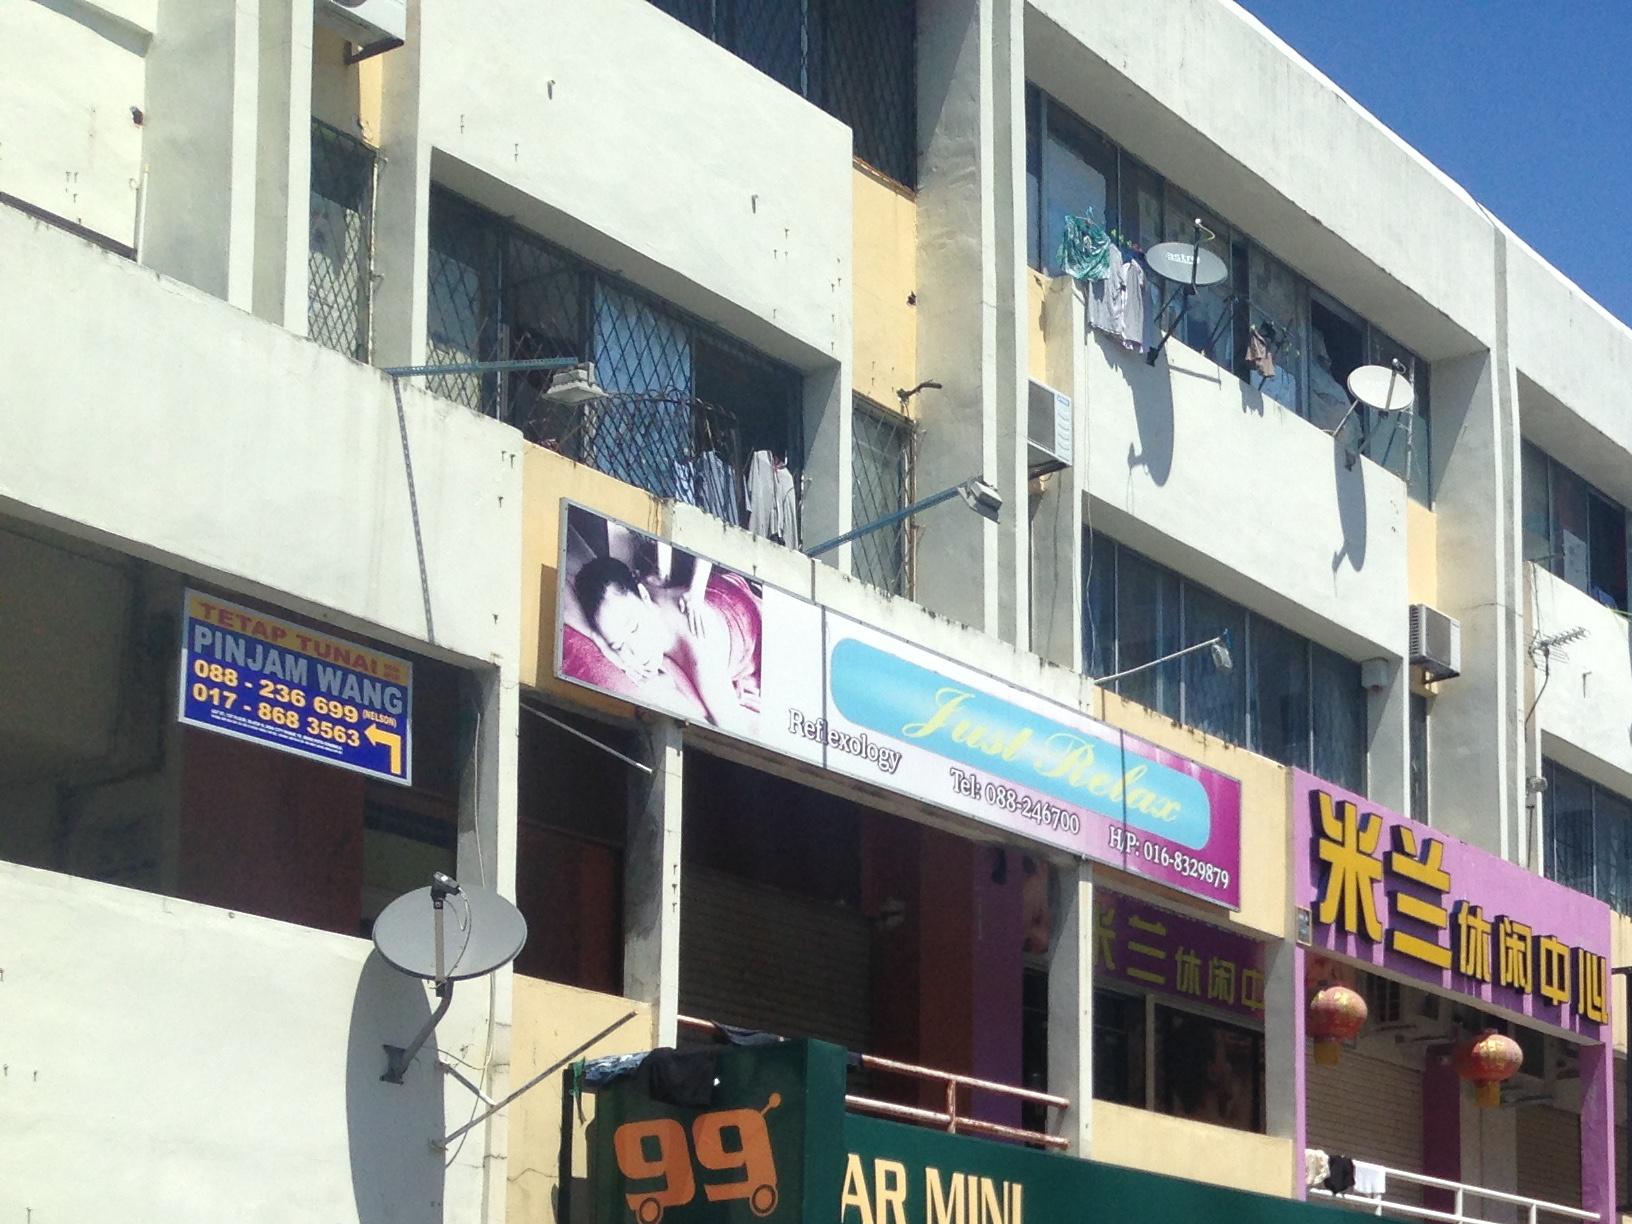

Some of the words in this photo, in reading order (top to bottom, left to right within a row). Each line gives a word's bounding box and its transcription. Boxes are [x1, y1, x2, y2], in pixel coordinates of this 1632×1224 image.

[193, 624, 308, 686] PINJAM
[316, 663, 403, 714] WANG
[198, 601, 288, 642] TETAP
[296, 635, 377, 673] TUNAI
[192, 683, 237, 710] 017
[258, 702, 300, 729] 868
[306, 717, 360, 748] 3563
[194, 659, 239, 688] 088
[259, 679, 306, 708] 236
[313, 696, 359, 724] 699
[788, 709, 902, 774] Reflexology
[902, 686, 1032, 763] Just
[1033, 732, 1183, 824] Relax
[950, 767, 982, 801] Tel:
[985, 784, 1080, 834] 088-246700
[1108, 826, 1140, 858] H/P:
[1143, 840, 1230, 890] 016-8329879
[1310, 789, 1609, 1025] 米兰休闲中心
